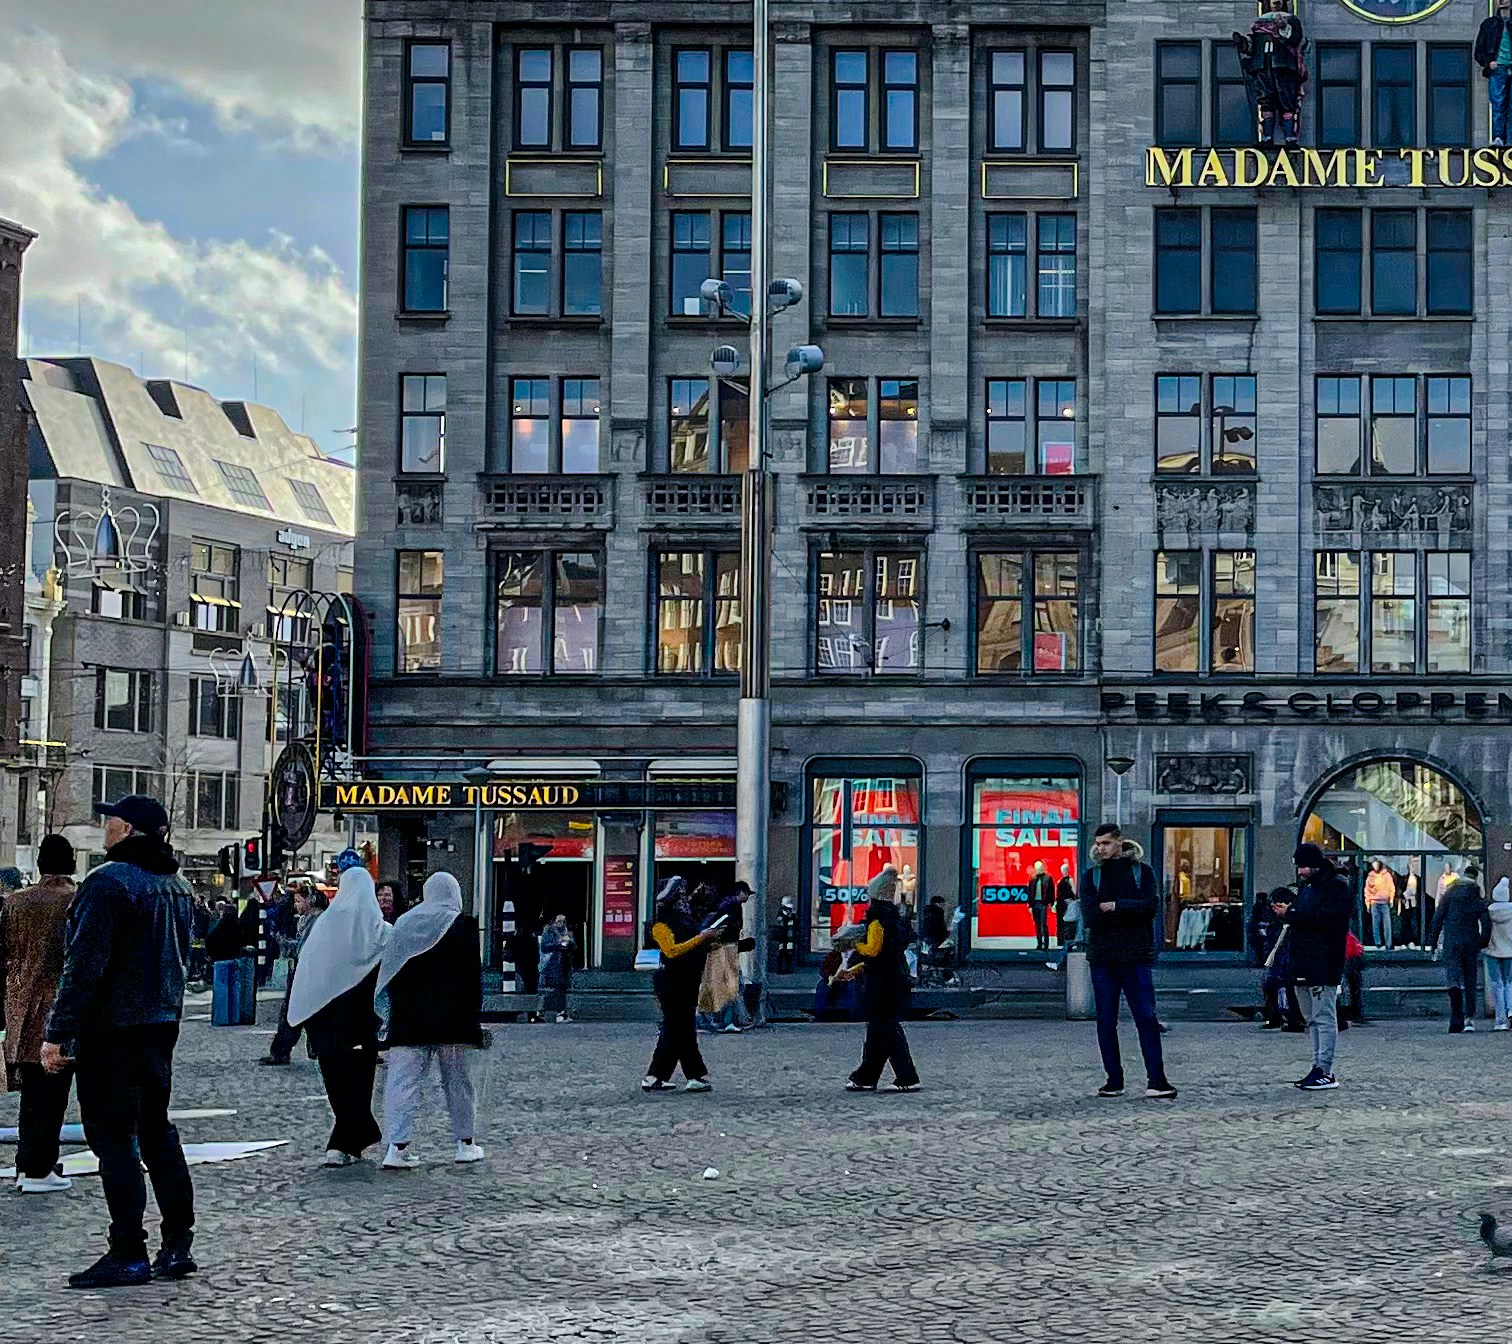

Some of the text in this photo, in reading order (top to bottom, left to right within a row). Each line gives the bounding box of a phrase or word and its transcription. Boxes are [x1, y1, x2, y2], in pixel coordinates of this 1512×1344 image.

[1145, 147, 1385, 188] MADAME
[335, 785, 579, 805] MADAME TUSSAUD
[996, 809, 1078, 824] FINAL
[996, 828, 1078, 847] SALE
[985, 888, 1028, 902] 50%
